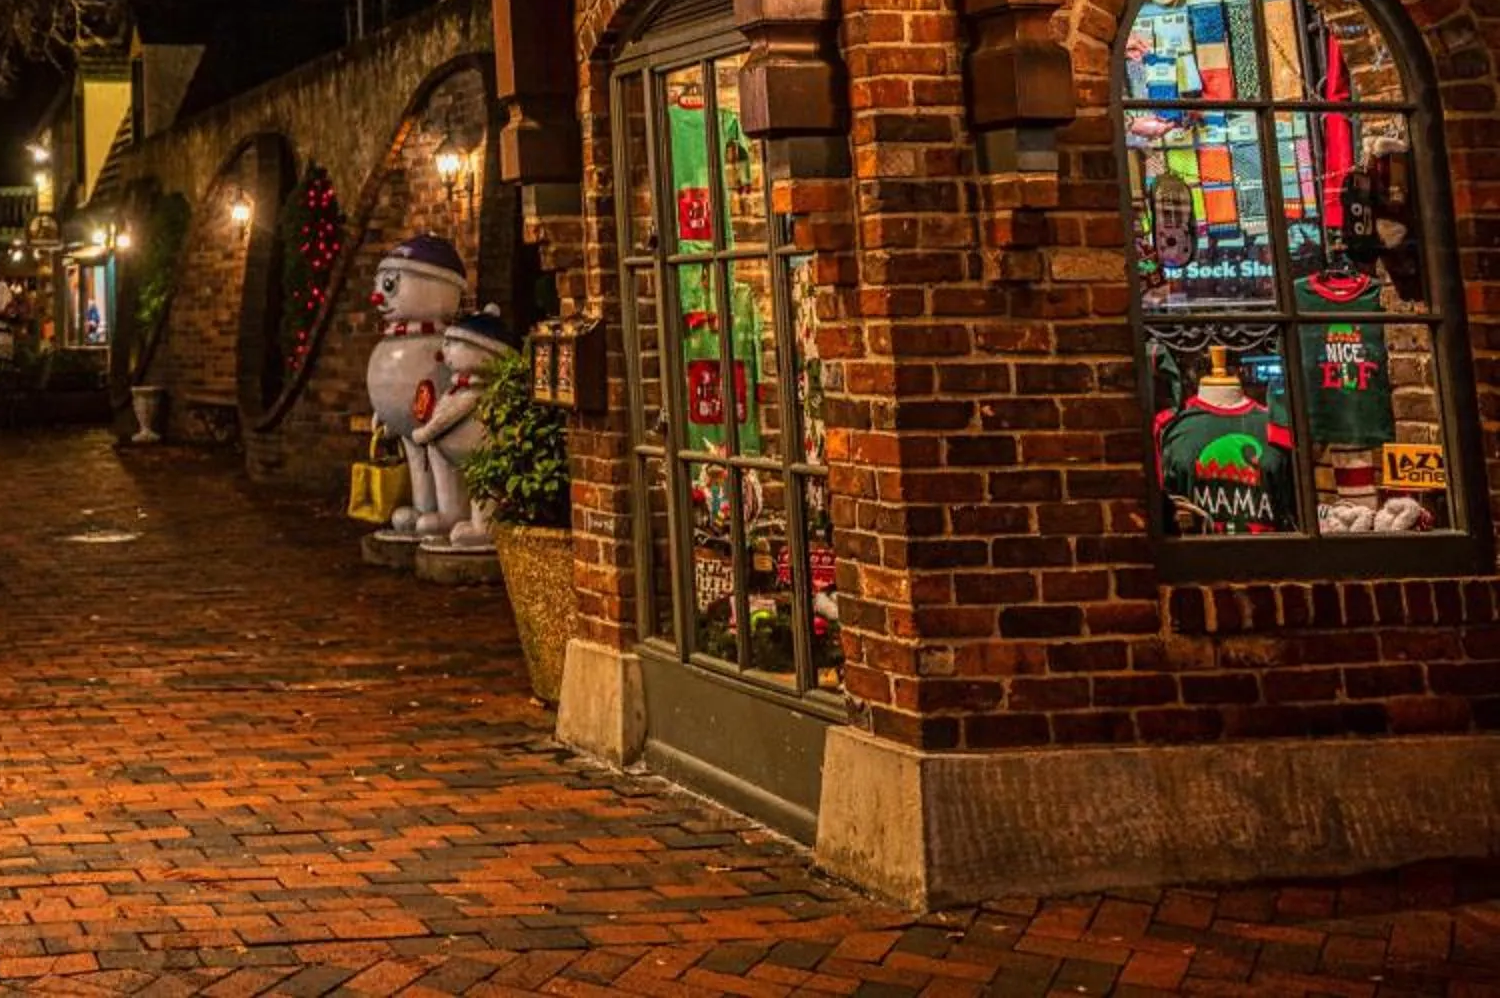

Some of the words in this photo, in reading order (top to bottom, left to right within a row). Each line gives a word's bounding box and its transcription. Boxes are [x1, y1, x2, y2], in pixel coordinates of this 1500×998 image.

[1187, 260, 1237, 279] Sock
[1325, 343, 1366, 363] NICE
[1317, 361, 1378, 393] ELF
[1194, 485, 1274, 521] MAMA
